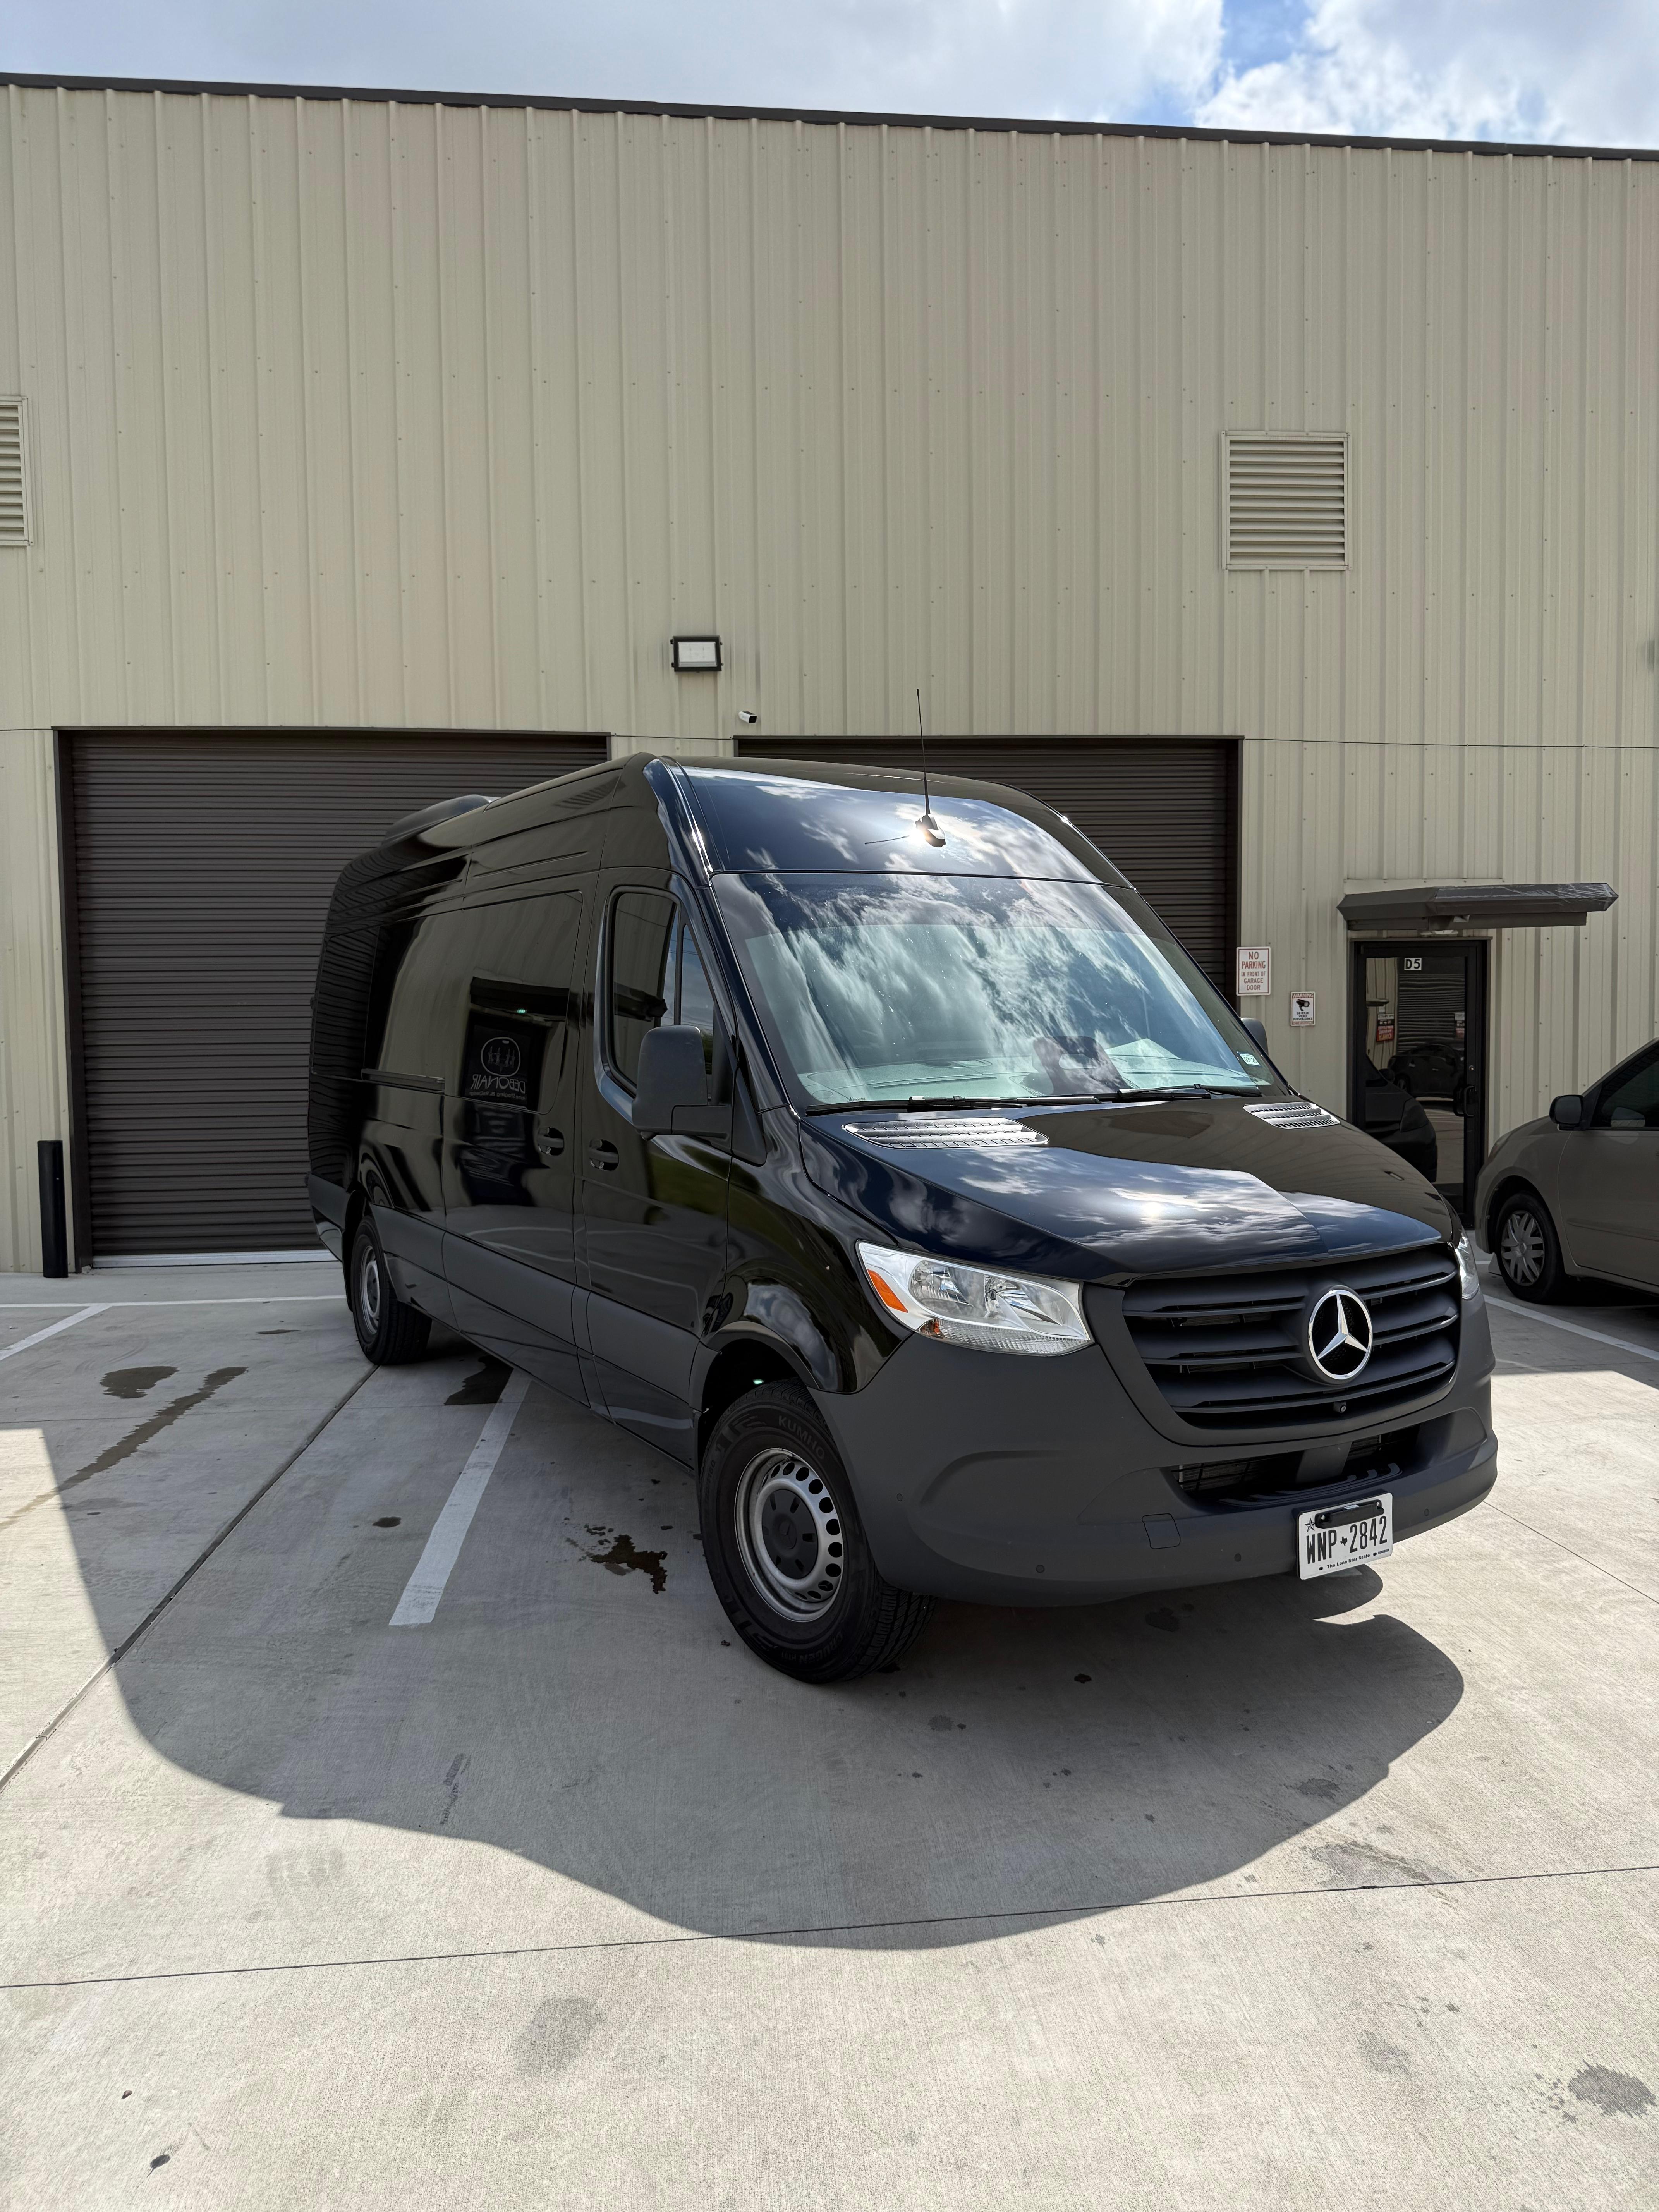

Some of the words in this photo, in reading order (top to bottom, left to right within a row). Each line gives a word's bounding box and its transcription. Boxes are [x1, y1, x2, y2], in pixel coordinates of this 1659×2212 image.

[1249, 951, 1259, 960] NO
[1242, 961, 1266, 969] PARKING
[1405, 959, 1420, 969] D5
[778, 1415, 825, 1460] KUMHO
[1306, 1530, 1337, 1564] WNP
[1350, 1516, 1388, 1553] 2842
